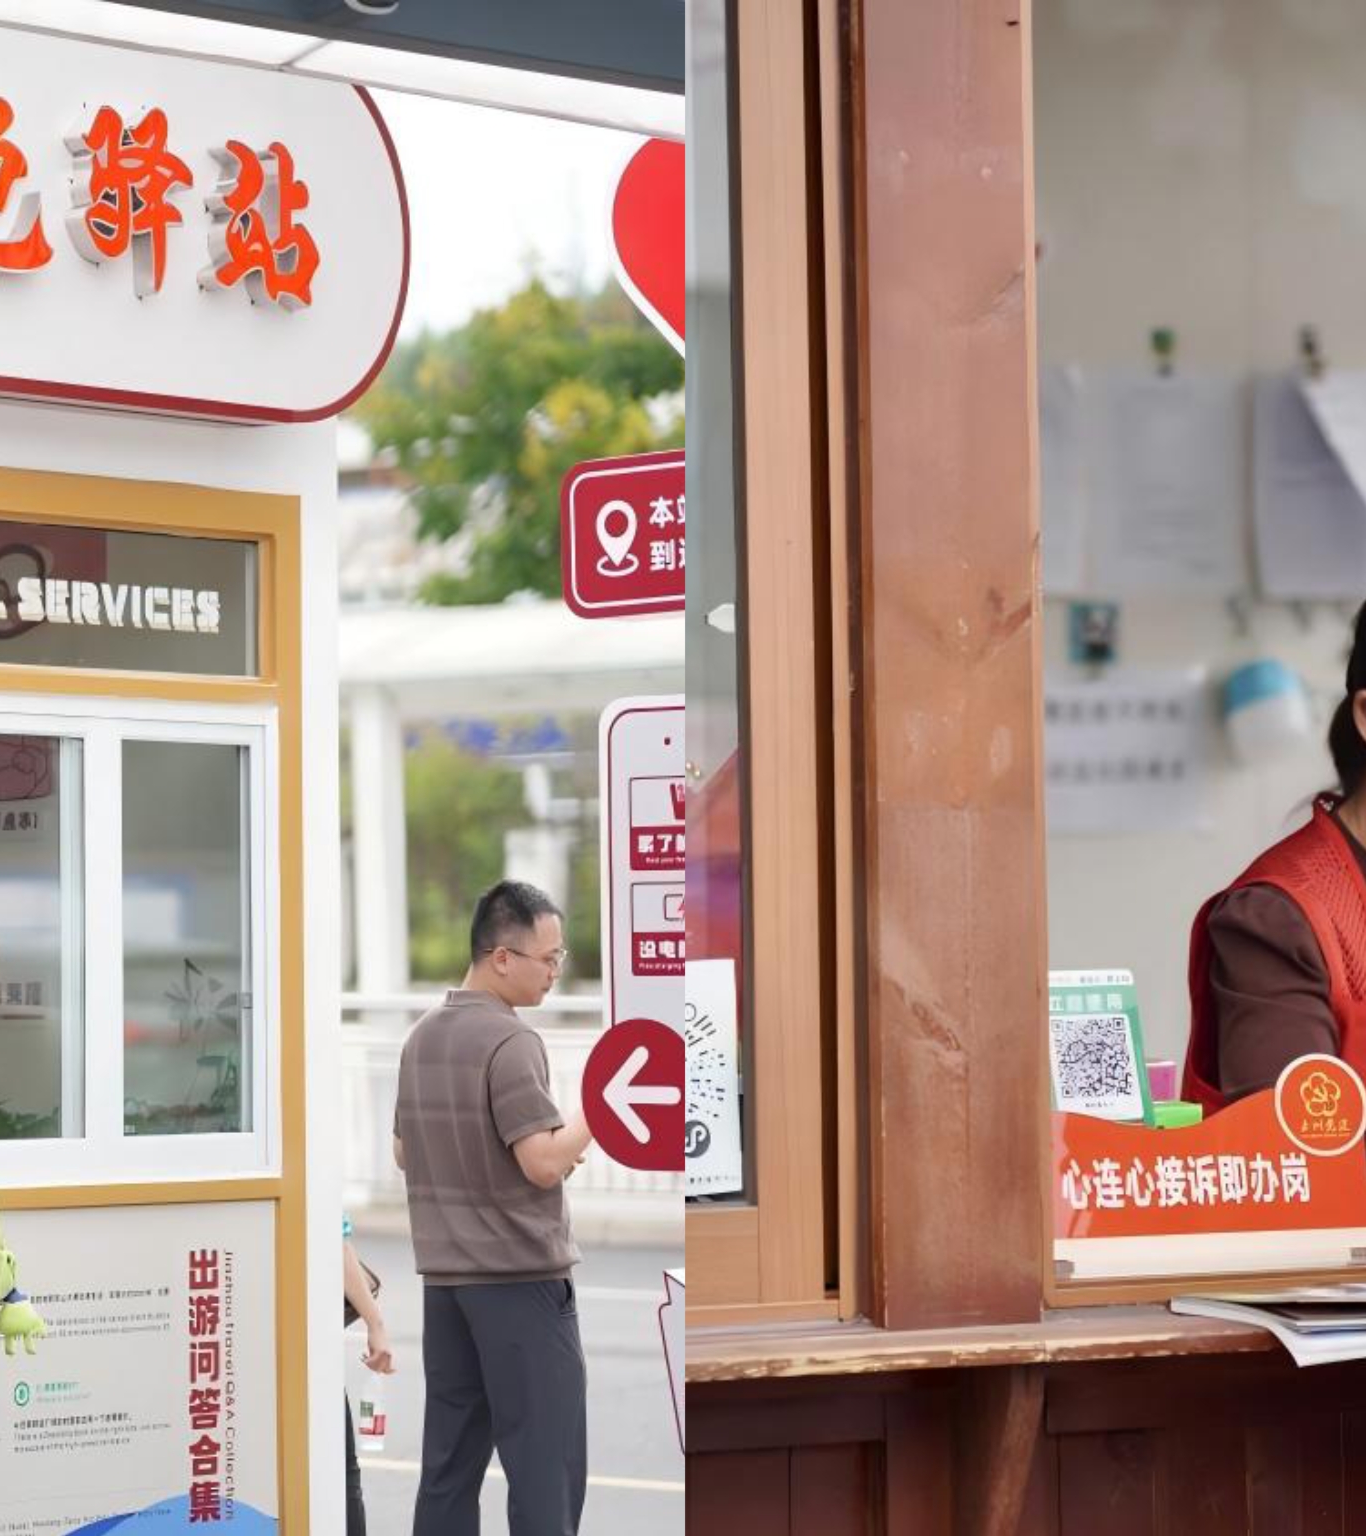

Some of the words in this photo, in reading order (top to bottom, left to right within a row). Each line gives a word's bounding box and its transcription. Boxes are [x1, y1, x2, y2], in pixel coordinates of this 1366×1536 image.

[19, 577, 221, 636] SERVICES
[1061, 1152, 1311, 1210] 心连心接诉即办岗
[188, 1248, 221, 1523] 出游问答合集
[225, 1380, 236, 1421] Q&A
[225, 1427, 236, 1520] Collection
